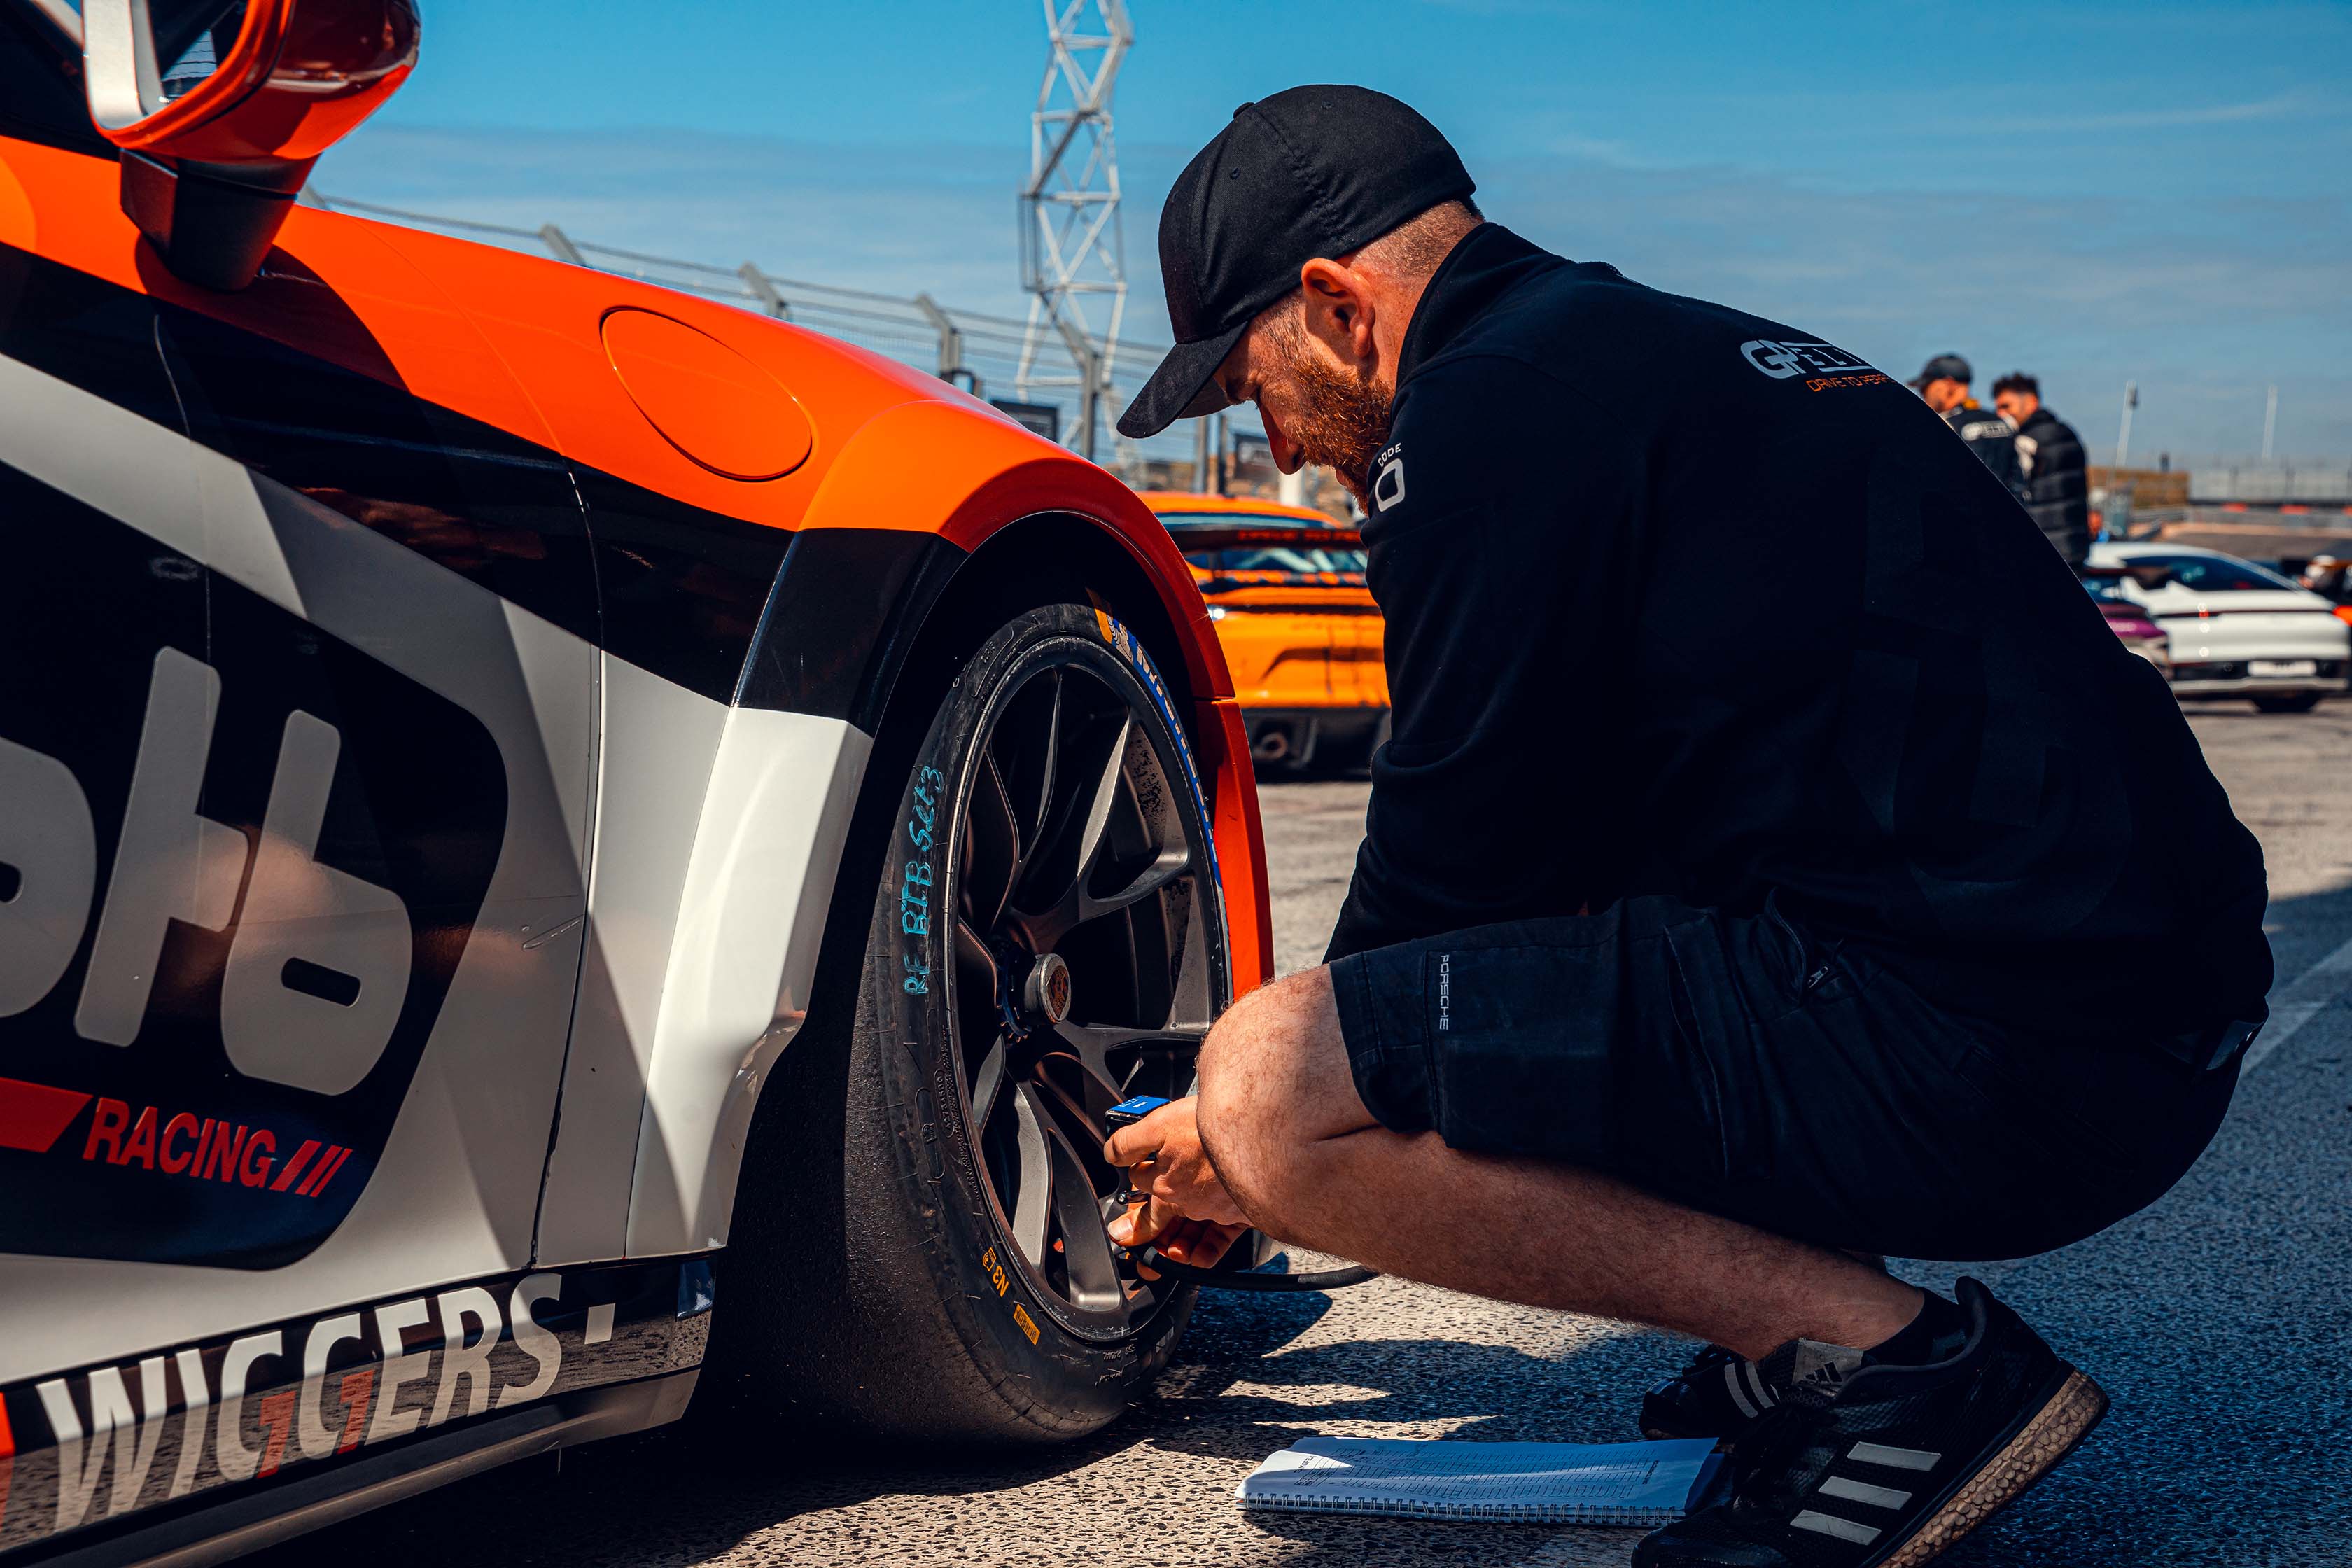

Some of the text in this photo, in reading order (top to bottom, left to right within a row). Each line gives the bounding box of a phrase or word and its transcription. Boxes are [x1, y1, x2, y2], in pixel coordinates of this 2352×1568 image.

[1805, 377, 1847, 392] DRIVE
[1842, 375, 1863, 386] TO
[1377, 442, 1401, 467] CODE
[901, 860, 933, 935] BTB
[1439, 953, 1450, 1031] PORSCHE
[81, 1097, 279, 1189] RACING
